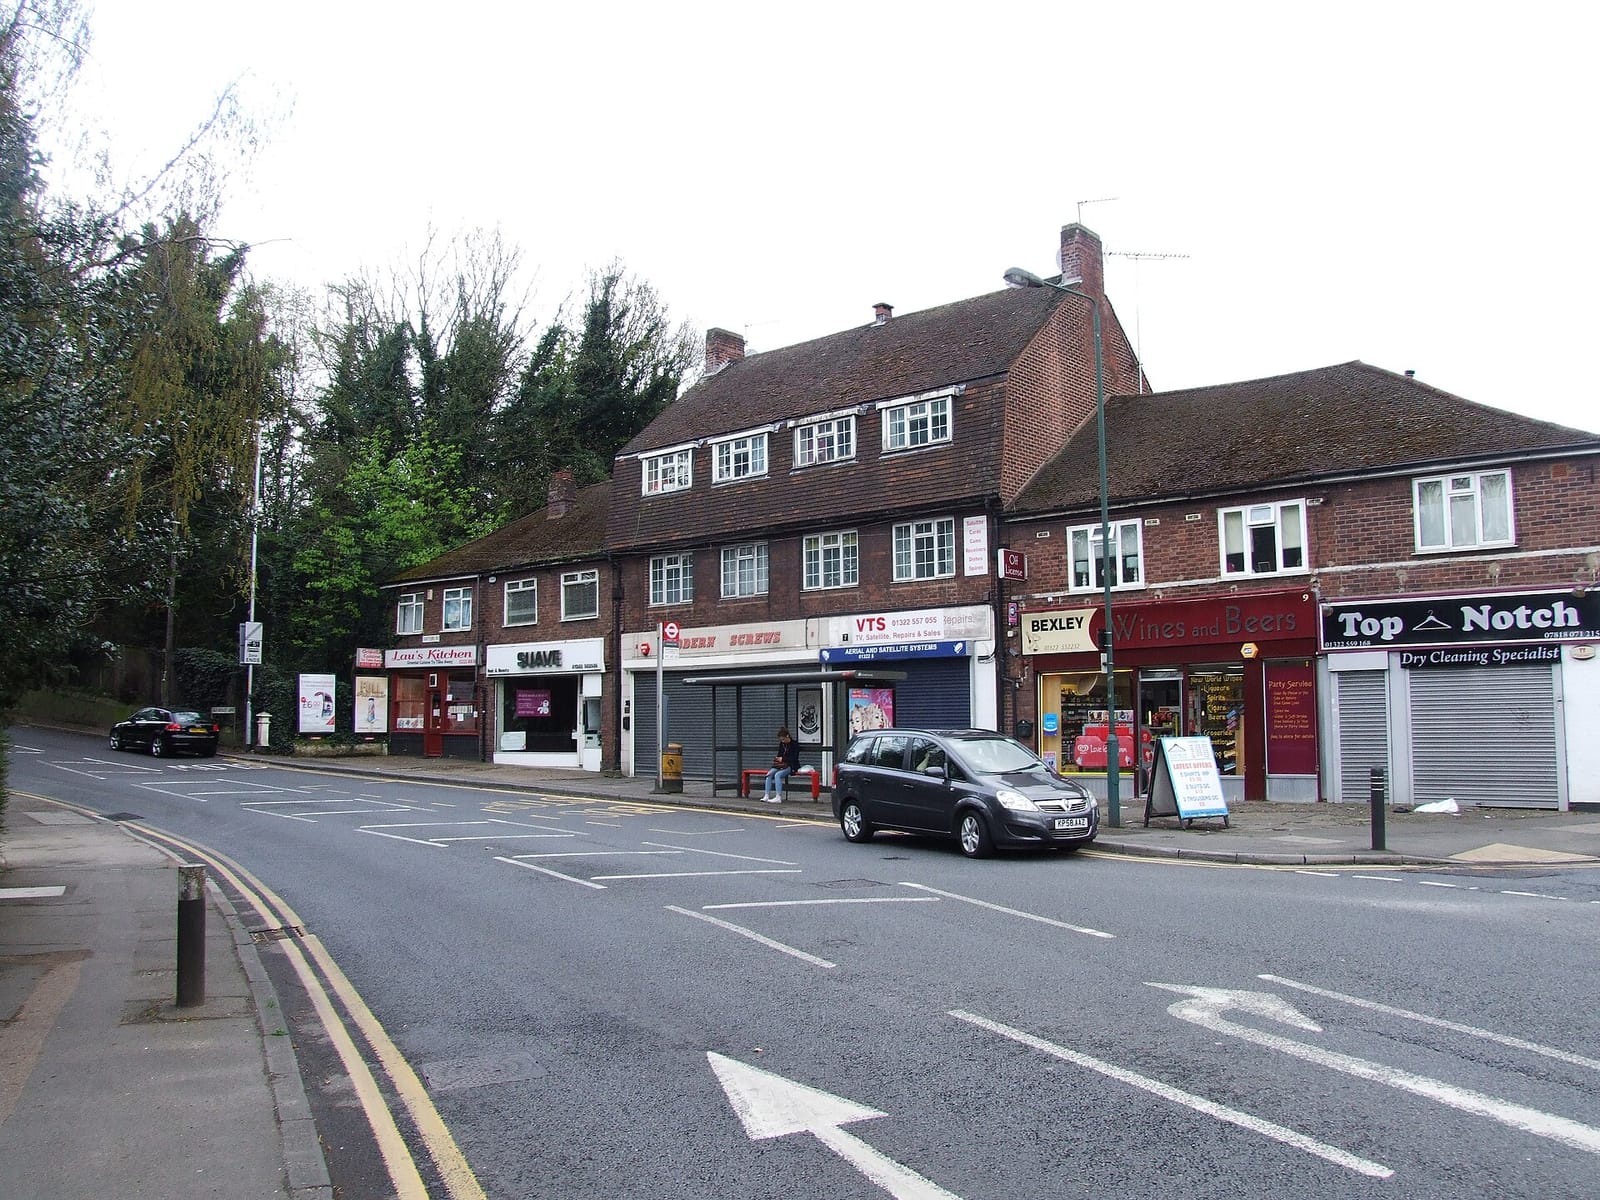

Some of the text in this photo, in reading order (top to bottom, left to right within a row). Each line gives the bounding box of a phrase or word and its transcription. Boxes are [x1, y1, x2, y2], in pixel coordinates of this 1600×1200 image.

[1008, 554, 1018, 566] Off
[1006, 563, 1022, 577] License
[1302, 594, 1309, 602] 9
[856, 616, 886, 632] VTS
[1032, 616, 1084, 632] BEXLEY
[1111, 605, 1296, 642] Wines and Beers
[1460, 600, 1581, 632] Notch
[1338, 612, 1404, 640] Top
[679, 631, 781, 650] DERN SCREWS
[893, 632, 916, 640] Repairs
[392, 648, 472, 661] Lau's Kitchen
[878, 645, 908, 653] SATELLITE
[910, 644, 938, 652] SYSTEMS
[1402, 646, 1560, 667] Dry Cleaning Specialist
[516, 650, 562, 668] SUAVE
[1268, 680, 1285, 689] Party
